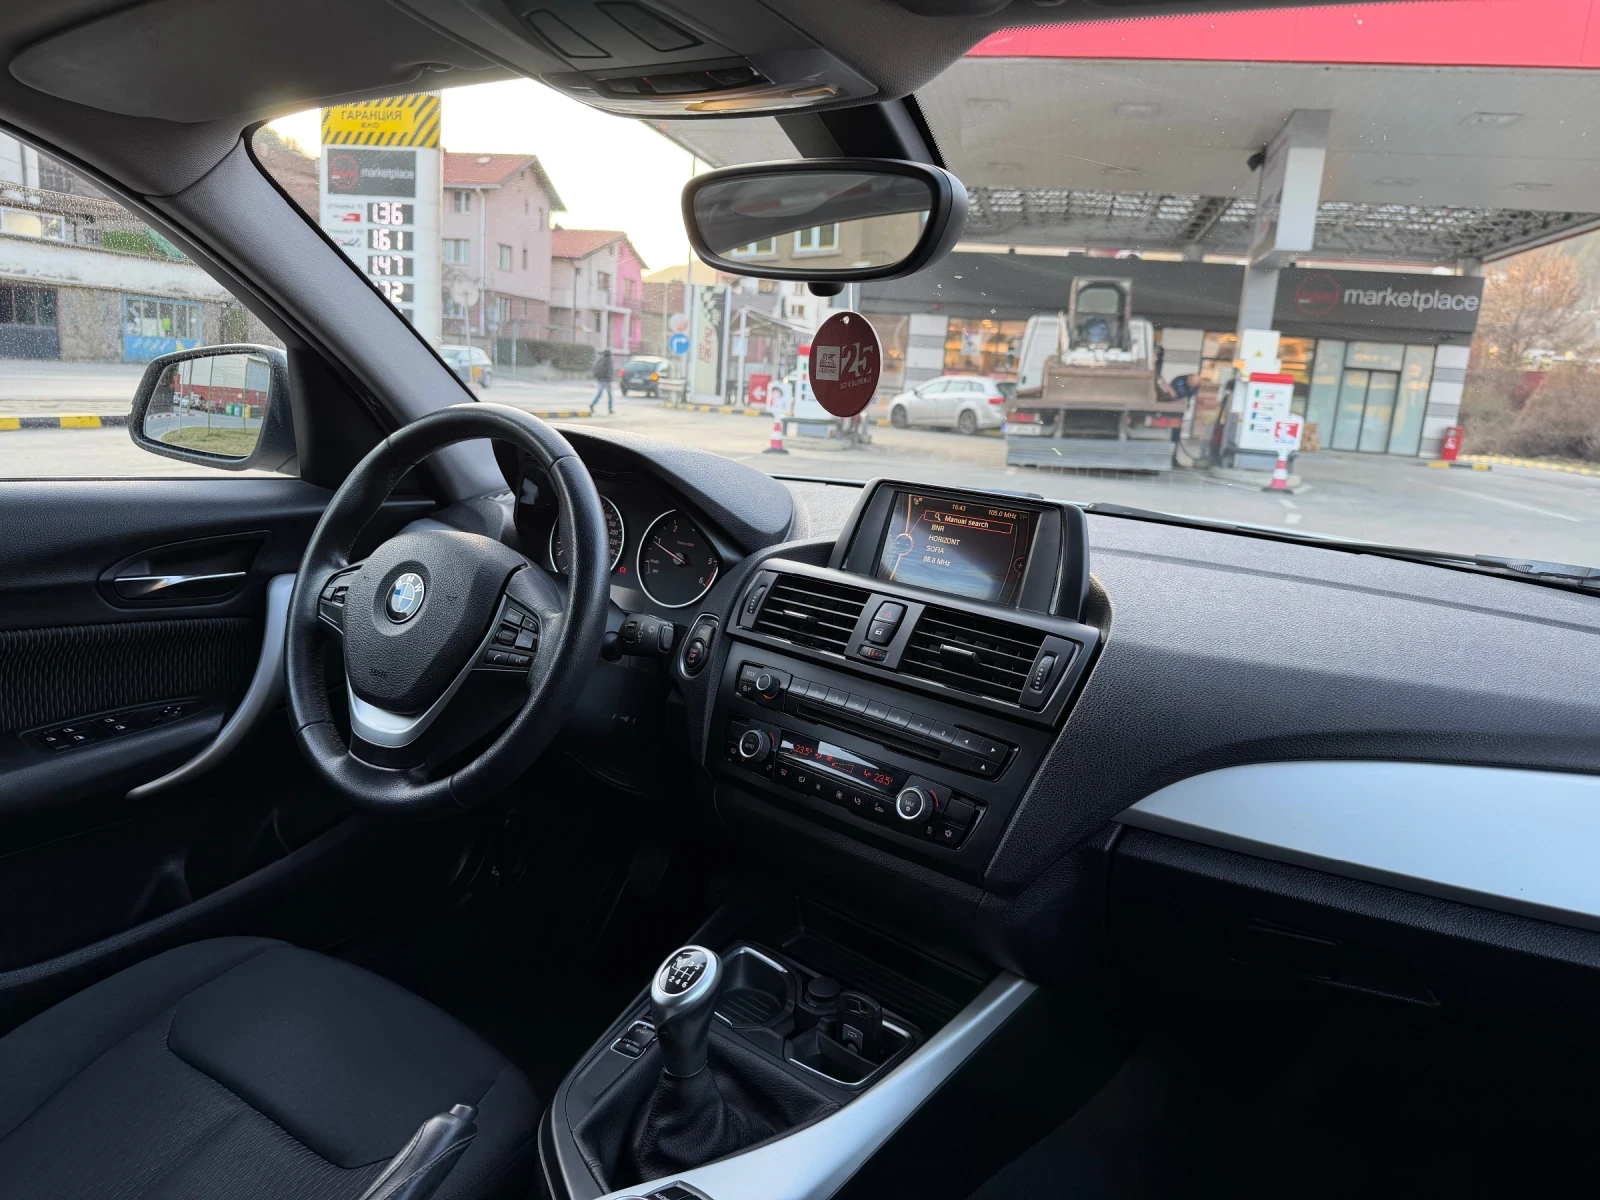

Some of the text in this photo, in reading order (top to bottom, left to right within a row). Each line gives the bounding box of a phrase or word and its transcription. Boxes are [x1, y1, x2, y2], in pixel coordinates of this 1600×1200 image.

[341, 110, 402, 121] ГАРАНЦИЯ
[360, 167, 414, 180] marketplace
[1344, 287, 1480, 312] marketplace
[841, 342, 873, 377] 25
[944, 515, 989, 528] Manual search
[1003, 512, 1017, 520] MHz
[928, 534, 960, 546] HORIZONT
[926, 545, 945, 554] SOFIA
[937, 558, 950, 567] MHz
[396, 575, 422, 592] BMW
